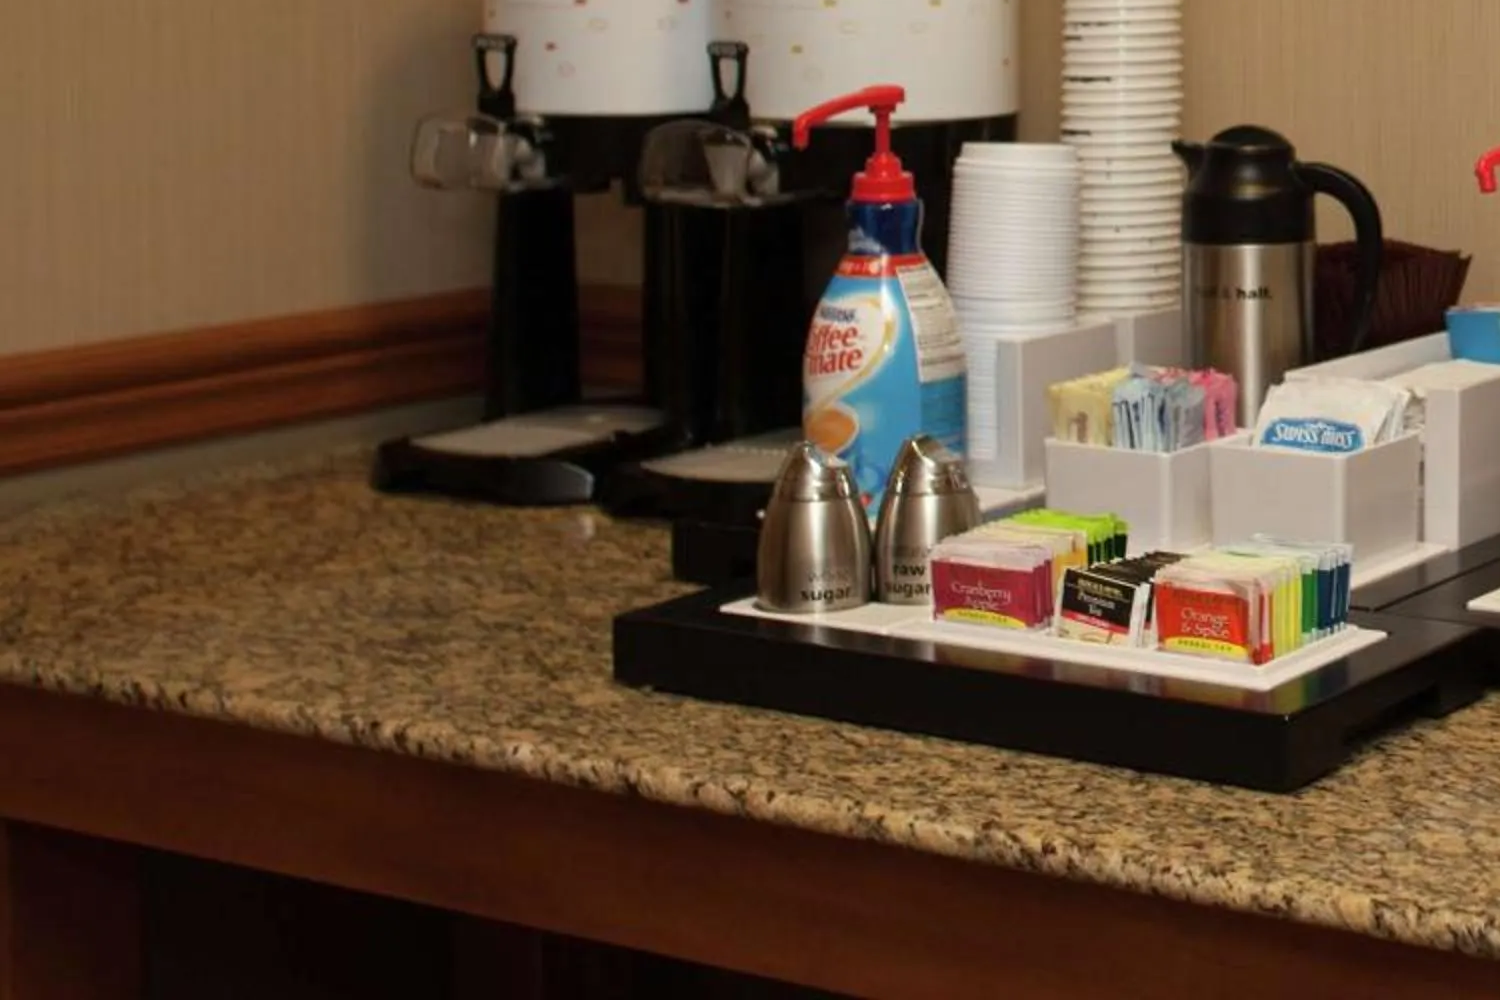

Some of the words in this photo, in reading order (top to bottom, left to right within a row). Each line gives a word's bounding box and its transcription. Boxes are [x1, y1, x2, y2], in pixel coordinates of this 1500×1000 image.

[893, 563, 926, 577] raw
[800, 585, 852, 604] sugar
[951, 580, 1012, 604] Cranberry
